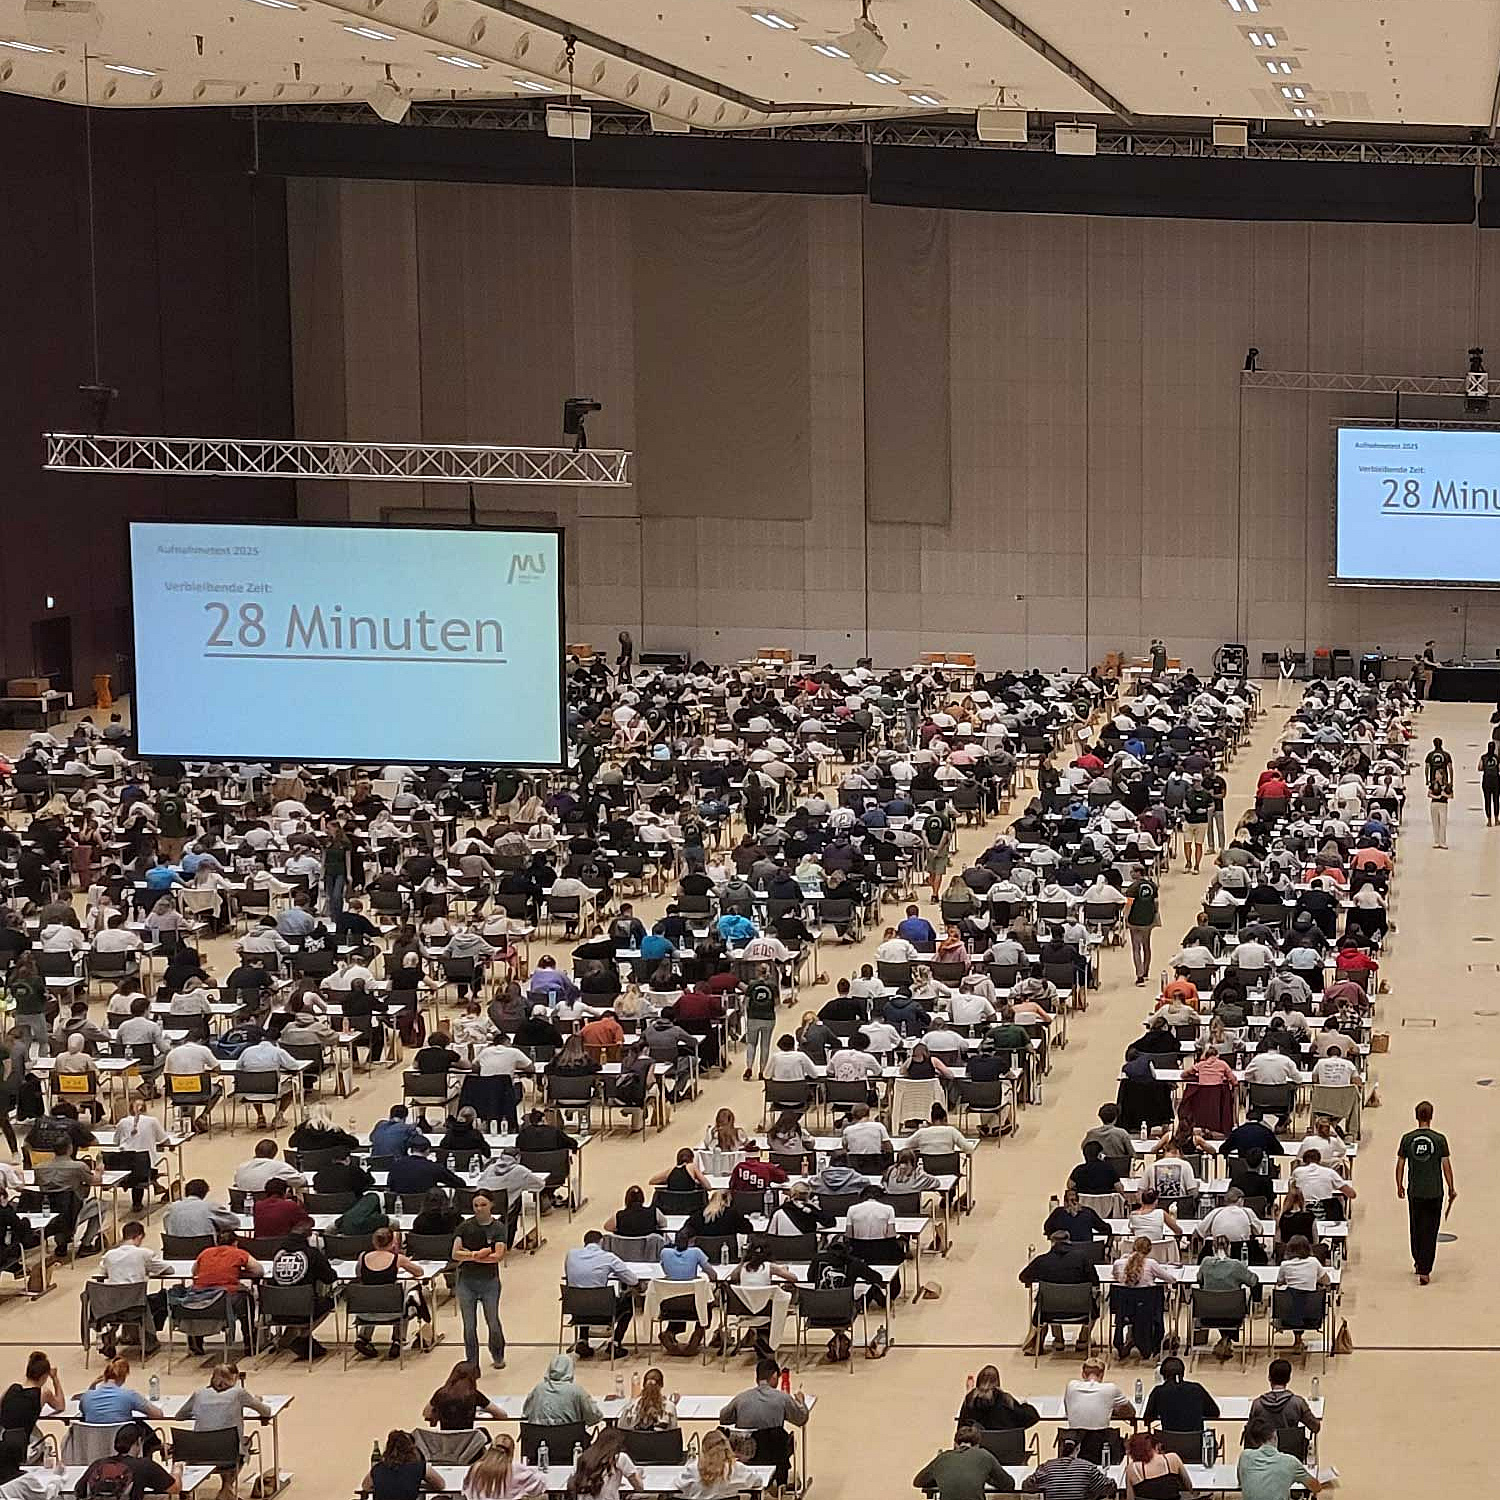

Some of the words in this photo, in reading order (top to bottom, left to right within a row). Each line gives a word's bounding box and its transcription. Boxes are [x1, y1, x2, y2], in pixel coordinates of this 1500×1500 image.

[1382, 479, 1420, 508] 28
[164, 581, 244, 594] Verbleibende
[204, 602, 266, 648] 28
[285, 604, 504, 653] Minuten
